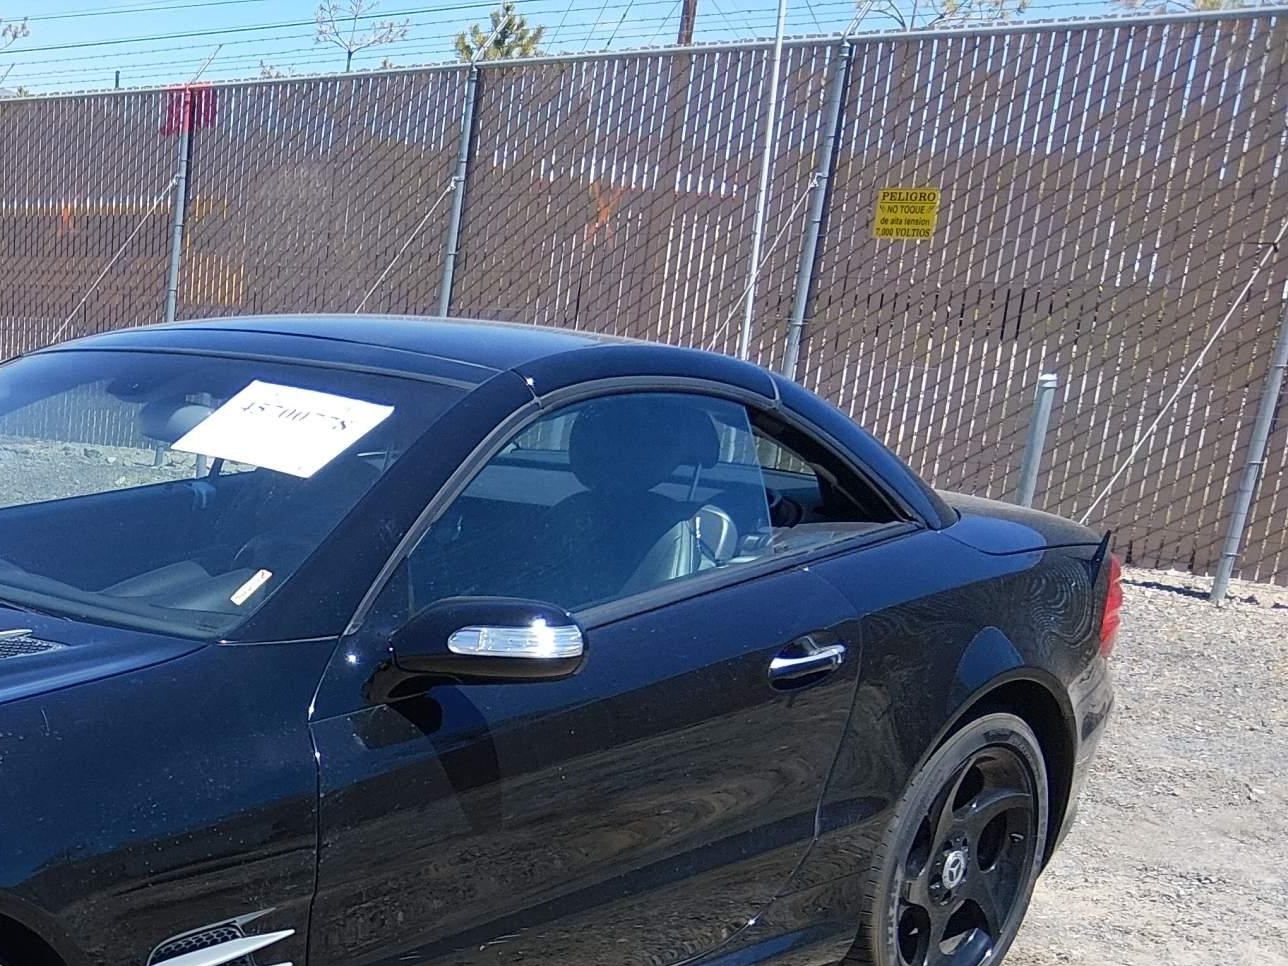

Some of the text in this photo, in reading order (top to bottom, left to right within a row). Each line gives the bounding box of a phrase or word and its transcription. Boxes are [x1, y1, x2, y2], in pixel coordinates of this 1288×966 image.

[881, 191, 936, 202] PELIGRO
[887, 205, 925, 214] NO TOQUE
[880, 217, 889, 225] de
[890, 217, 903, 225] alta
[895, 228, 931, 237] VOLTIOS
